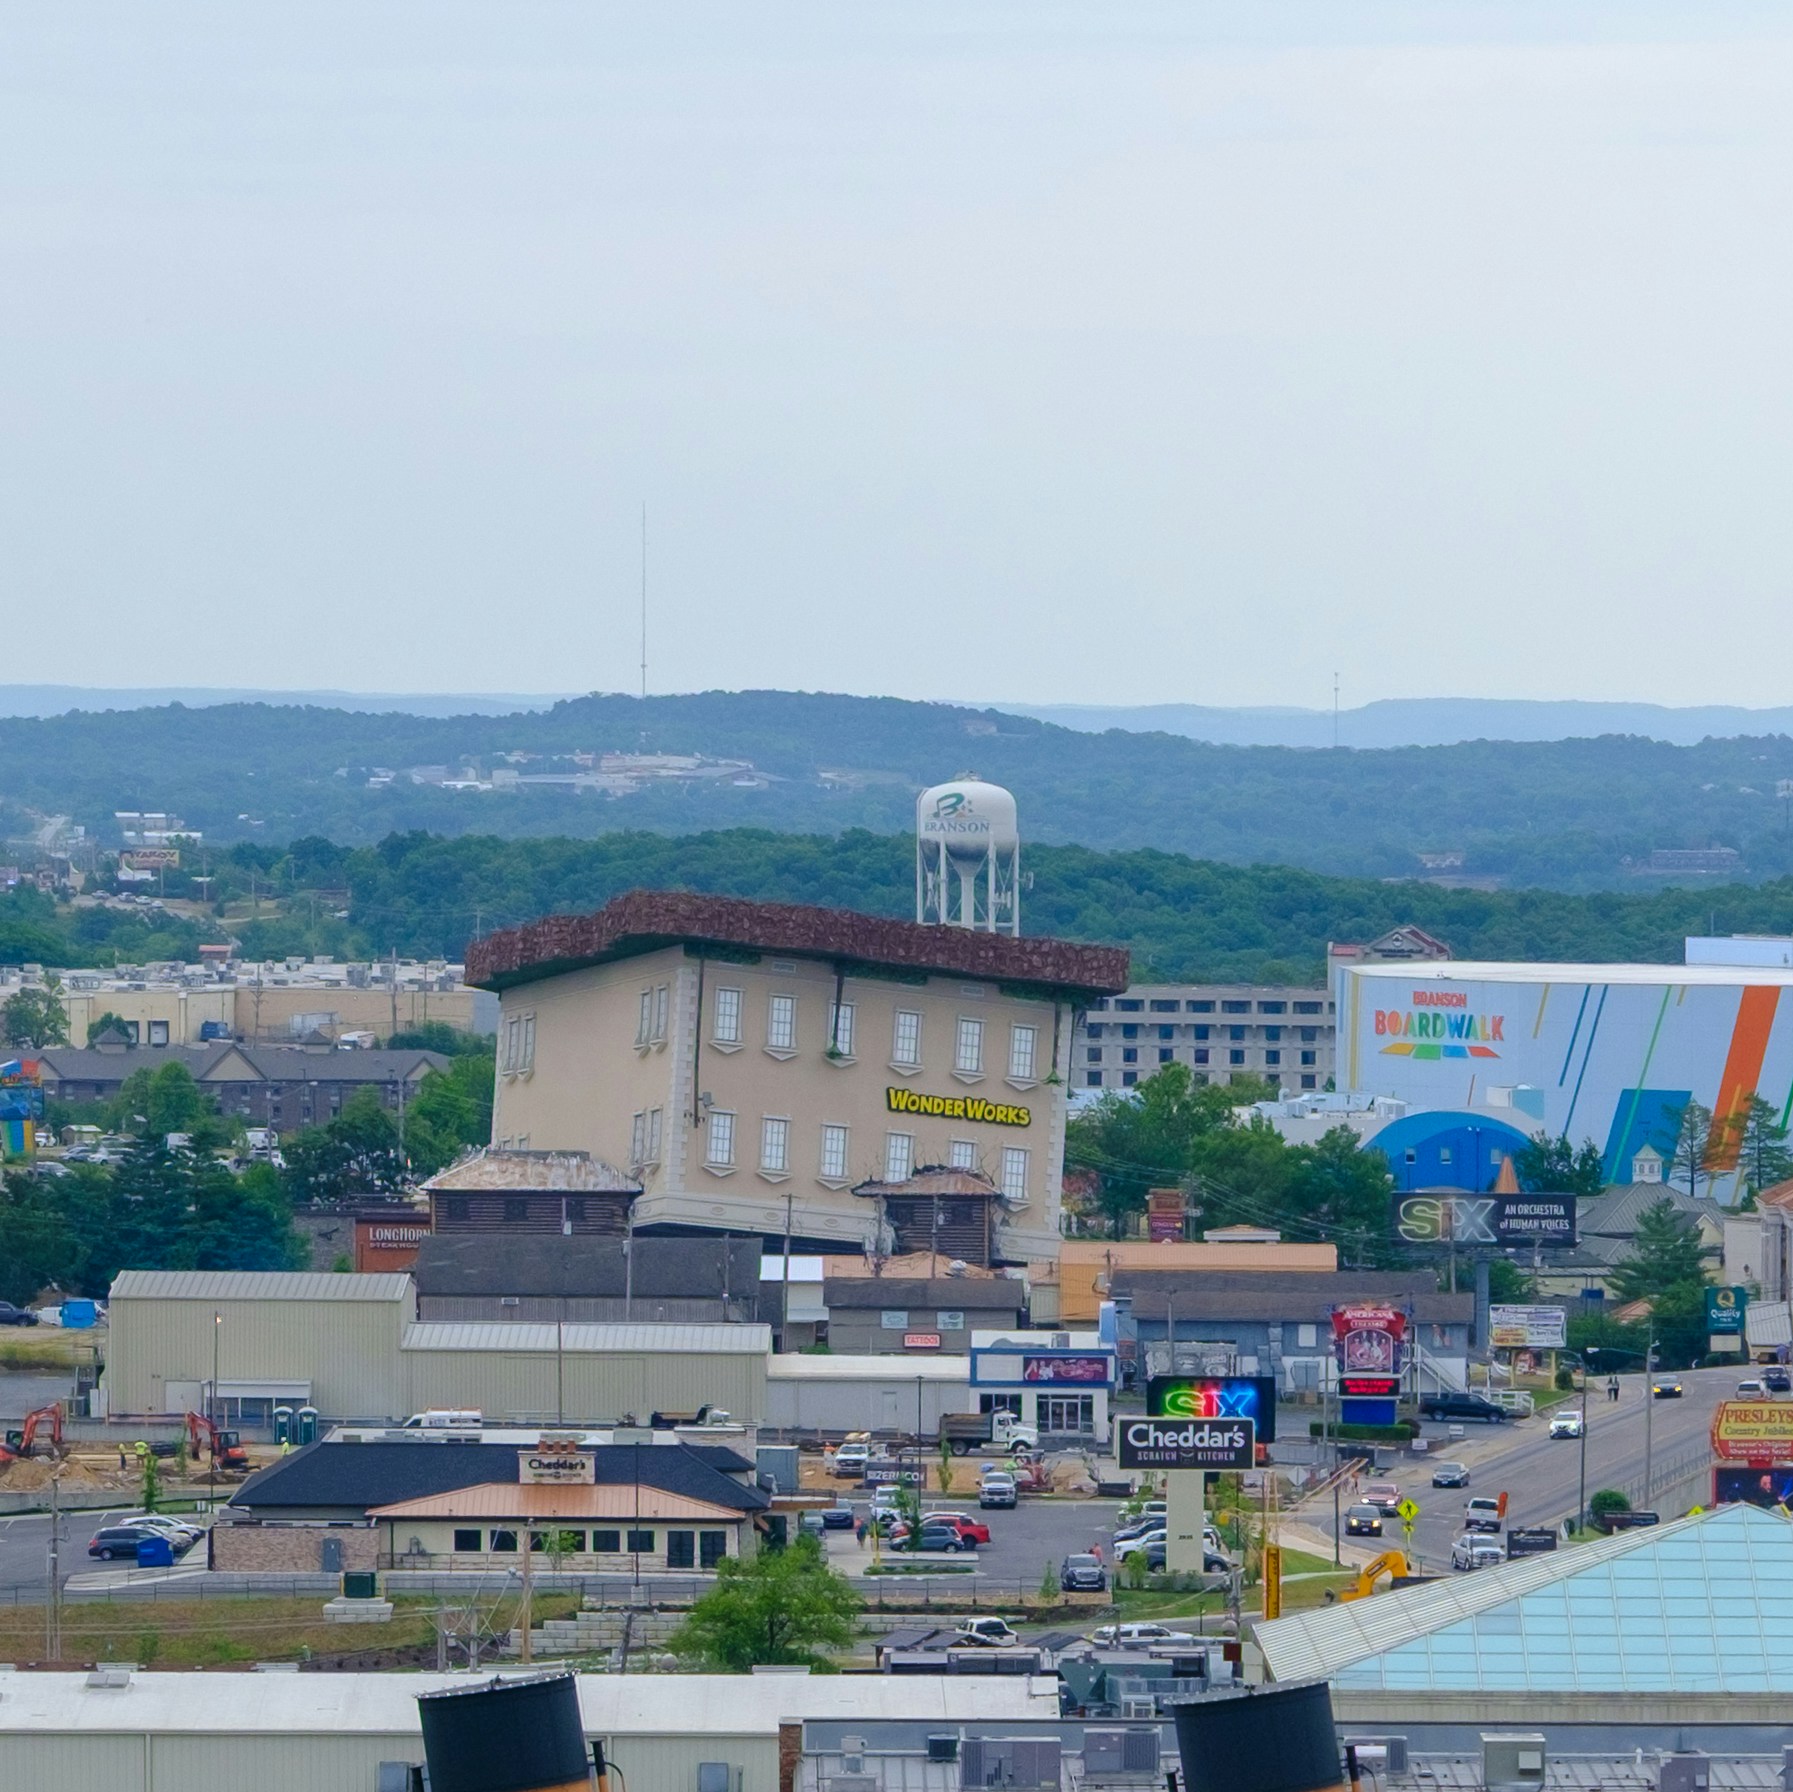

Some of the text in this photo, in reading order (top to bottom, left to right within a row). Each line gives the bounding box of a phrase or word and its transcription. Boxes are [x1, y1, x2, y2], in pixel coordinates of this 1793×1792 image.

[1412, 991, 1467, 1008] BRANSON
[1375, 1010, 1504, 1041] BOARDWALK
[888, 1088, 1031, 1126] WONDERWORKS
[1505, 1204, 1565, 1216] AN ORCHESTRA
[1398, 1198, 1498, 1241] SIX
[1509, 1219, 1539, 1230] HUMAN
[1541, 1219, 1570, 1230] VOICES
[1344, 1309, 1396, 1320] AMERICANA
[1711, 1309, 1741, 1319] Quality
[1127, 1423, 1245, 1448] Cheddar's
[1725, 1426, 1760, 1436] Country
[1137, 1451, 1235, 1461] SCRATCH KITCHEN
[528, 1458, 586, 1470] Cheddar's
